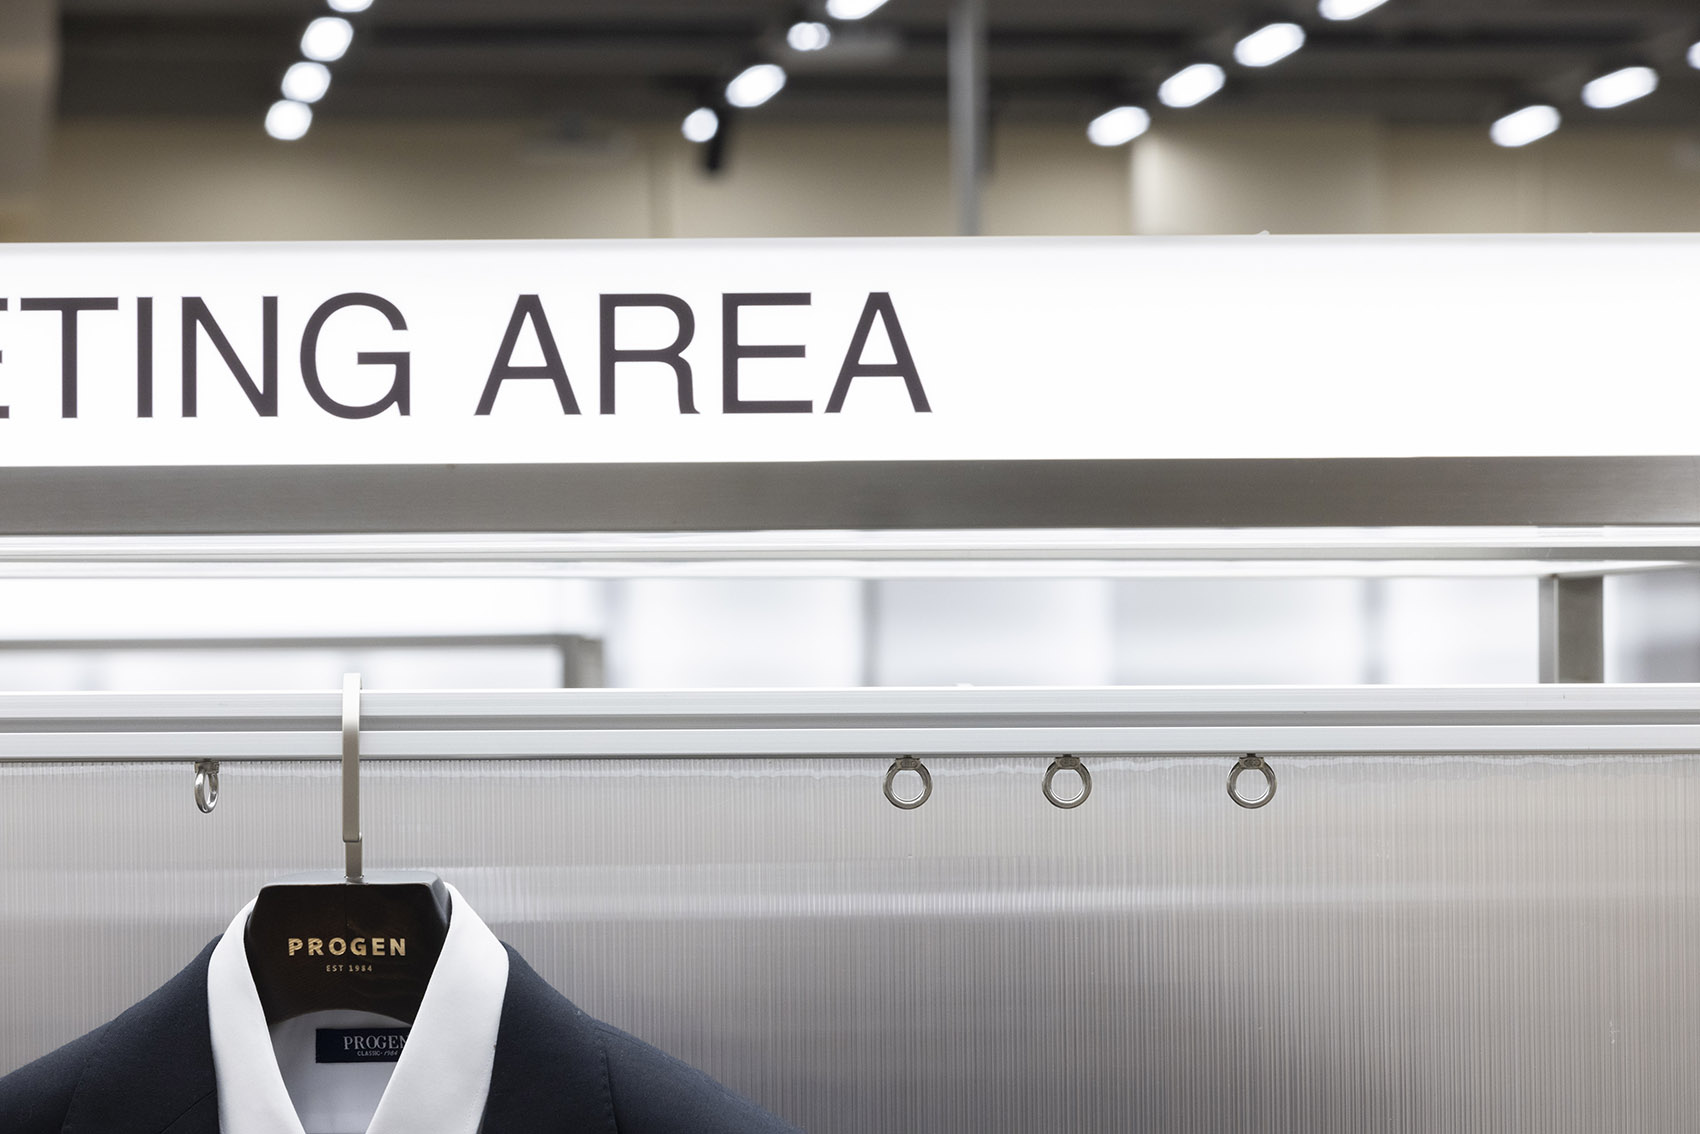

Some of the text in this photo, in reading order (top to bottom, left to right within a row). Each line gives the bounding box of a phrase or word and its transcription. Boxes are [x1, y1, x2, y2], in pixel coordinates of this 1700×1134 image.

[0, 291, 932, 420] TING AREA
[287, 937, 406, 956] PROGEN
[325, 964, 373, 972] EST 1984
